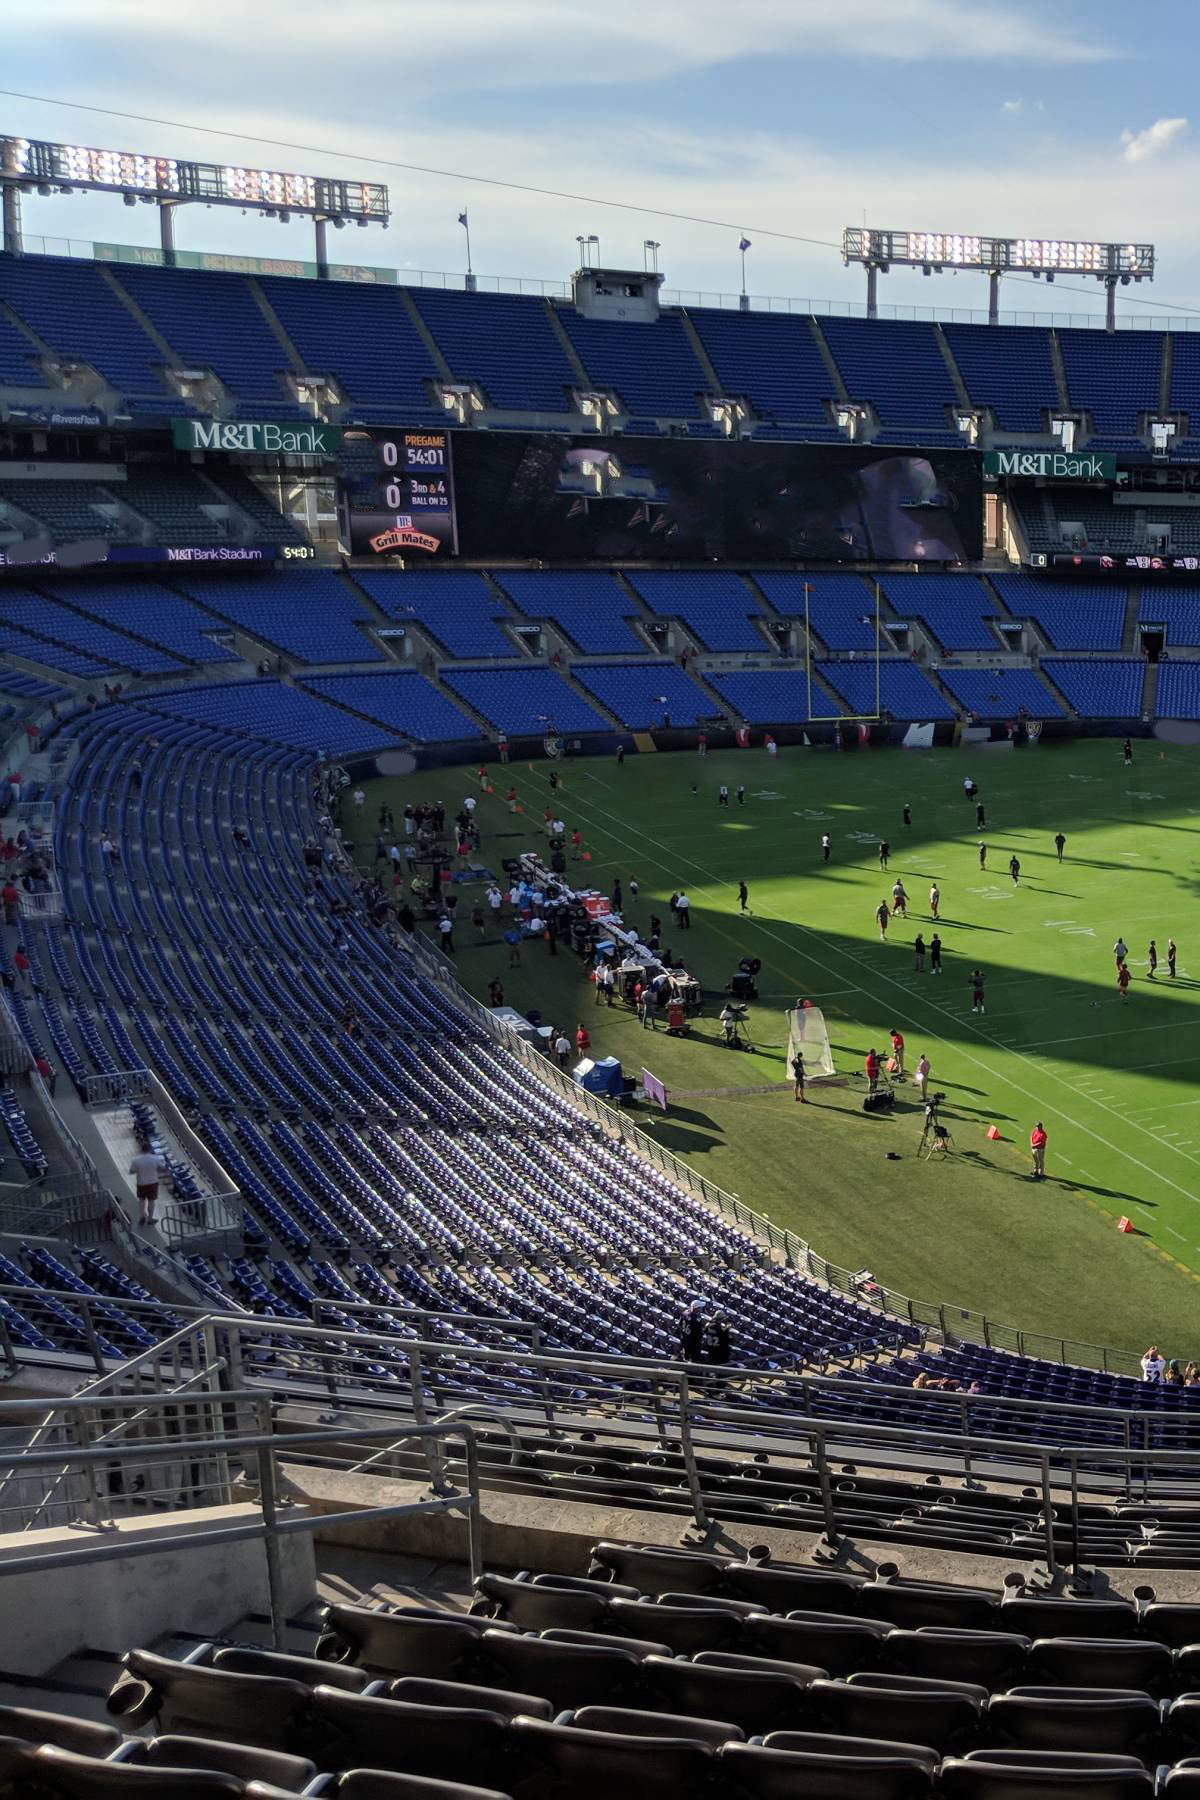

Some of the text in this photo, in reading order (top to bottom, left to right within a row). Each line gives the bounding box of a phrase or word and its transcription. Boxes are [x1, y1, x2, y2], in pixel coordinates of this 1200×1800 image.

[52, 414, 100, 426] #RavensFlock
[191, 421, 327, 452] M&T Bank
[405, 435, 446, 448] PREGAME
[383, 442, 398, 466] 0
[407, 449, 444, 465] 54:01
[997, 452, 1104, 477] M&T Bank
[411, 480, 446, 494] 3RD & 4
[386, 484, 401, 508] 0
[412, 497, 448, 506] BALL ON 25
[376, 534, 434, 548] Grill Mates
[167, 548, 262, 561] M&T Bank Stadium
[283, 547, 315, 559] 54:01
